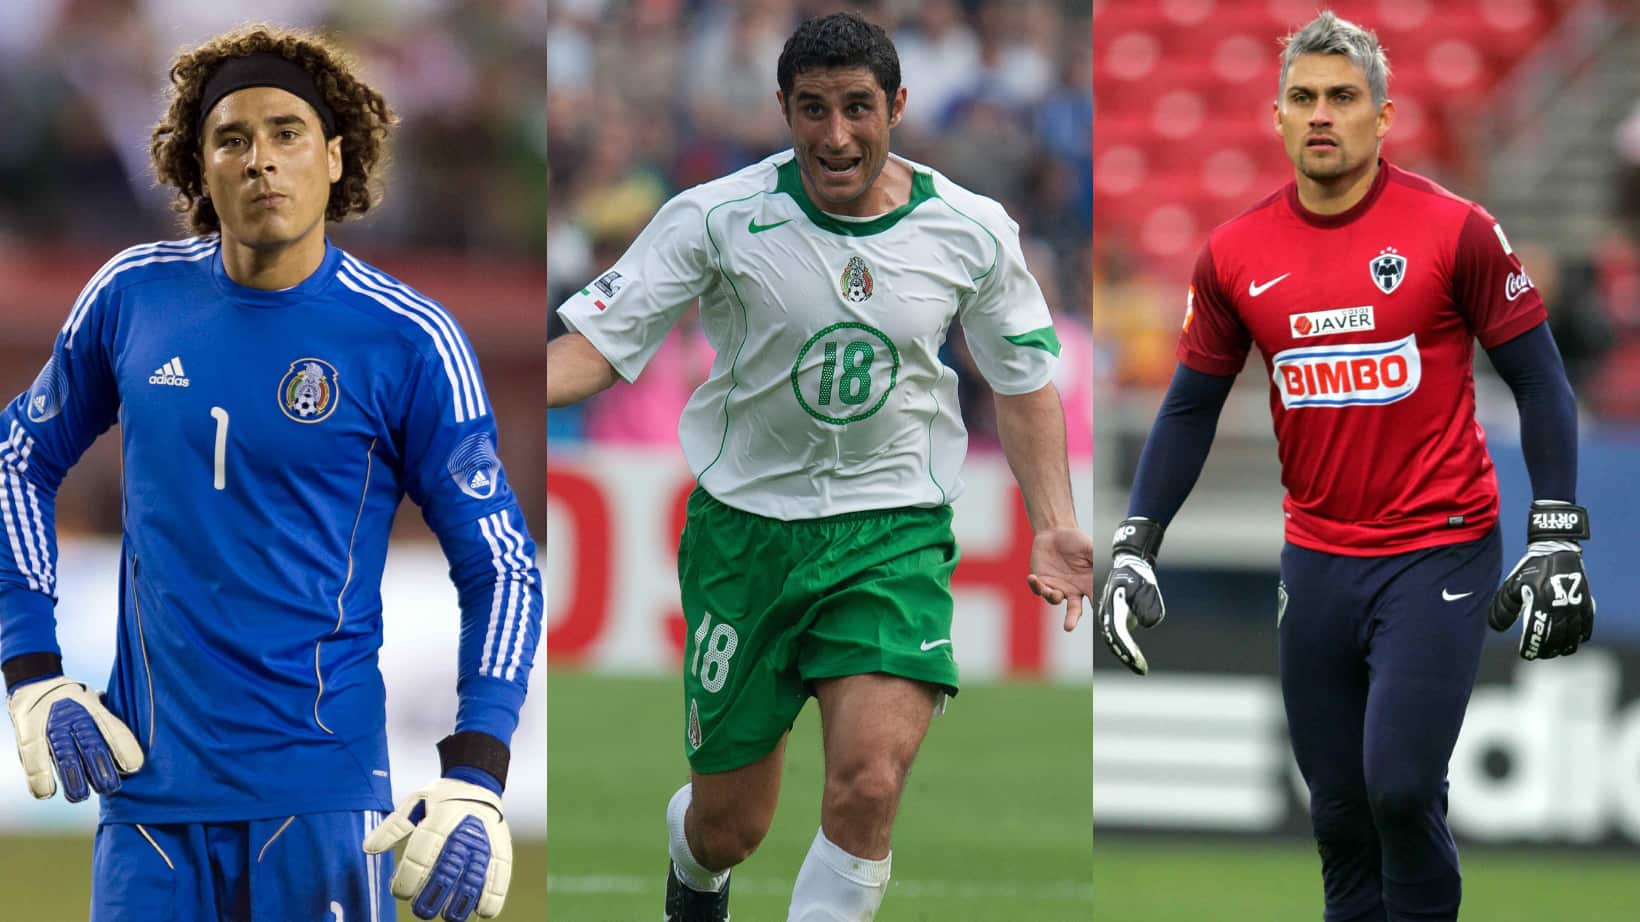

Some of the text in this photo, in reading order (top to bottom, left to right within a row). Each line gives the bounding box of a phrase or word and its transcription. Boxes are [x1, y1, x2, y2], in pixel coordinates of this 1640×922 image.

[1312, 313, 1372, 334] JAVER
[149, 374, 190, 388] adidas
[818, 341, 875, 405] 18
[1279, 354, 1408, 396] BIMBO
[210, 406, 229, 490] 1
[1533, 512, 1578, 525] ORTIZ
[691, 611, 739, 693] 18
